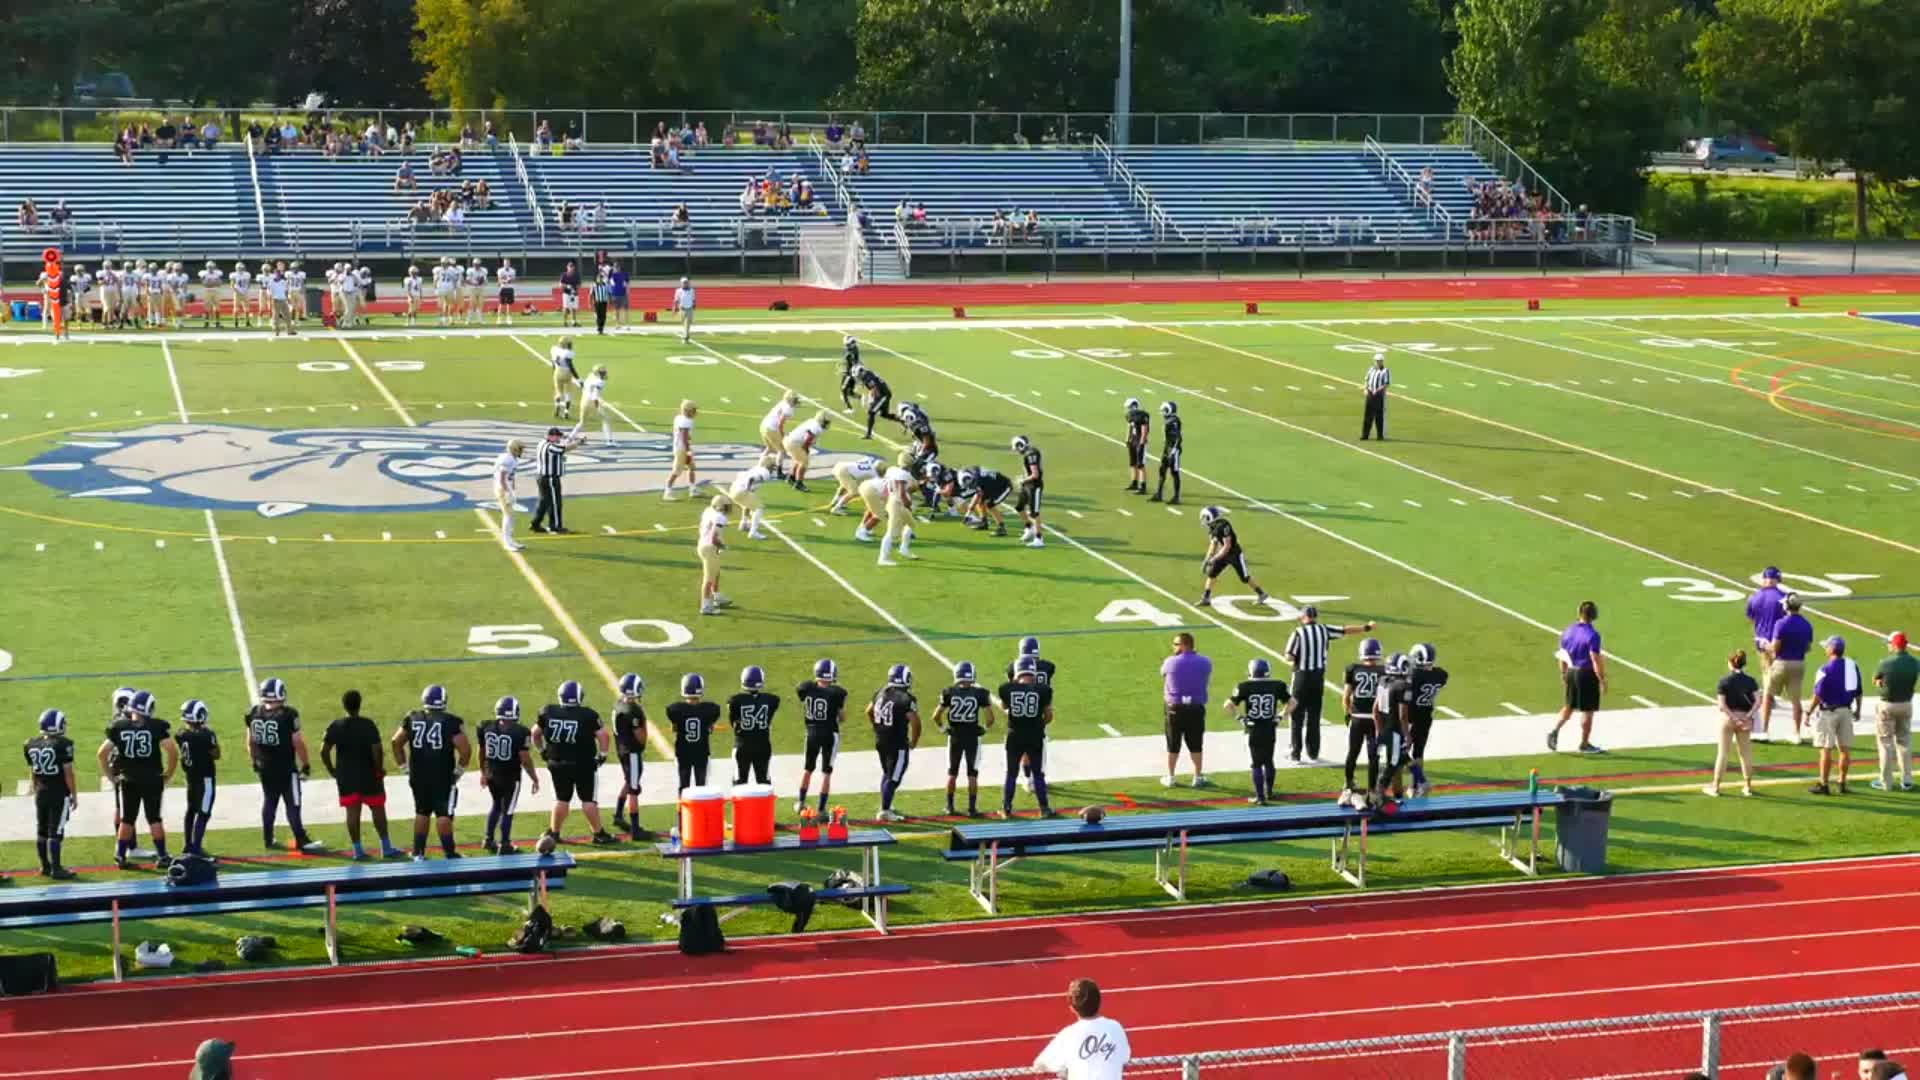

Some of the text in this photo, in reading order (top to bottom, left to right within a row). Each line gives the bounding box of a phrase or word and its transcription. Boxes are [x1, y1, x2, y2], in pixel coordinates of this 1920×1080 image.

[1094, 595, 1304, 626] 40
[466, 619, 694, 655] 50
[740, 705, 769, 730] 54
[950, 696, 978, 722] 22
[1010, 691, 1040, 718] 58
[1248, 694, 1275, 719] 33
[251, 719, 280, 746] 66
[412, 721, 442, 749] 74
[549, 720, 578, 744] 77
[685, 718, 701, 742] 9
[121, 730, 152, 758] 73
[484, 731, 512, 761] 60
